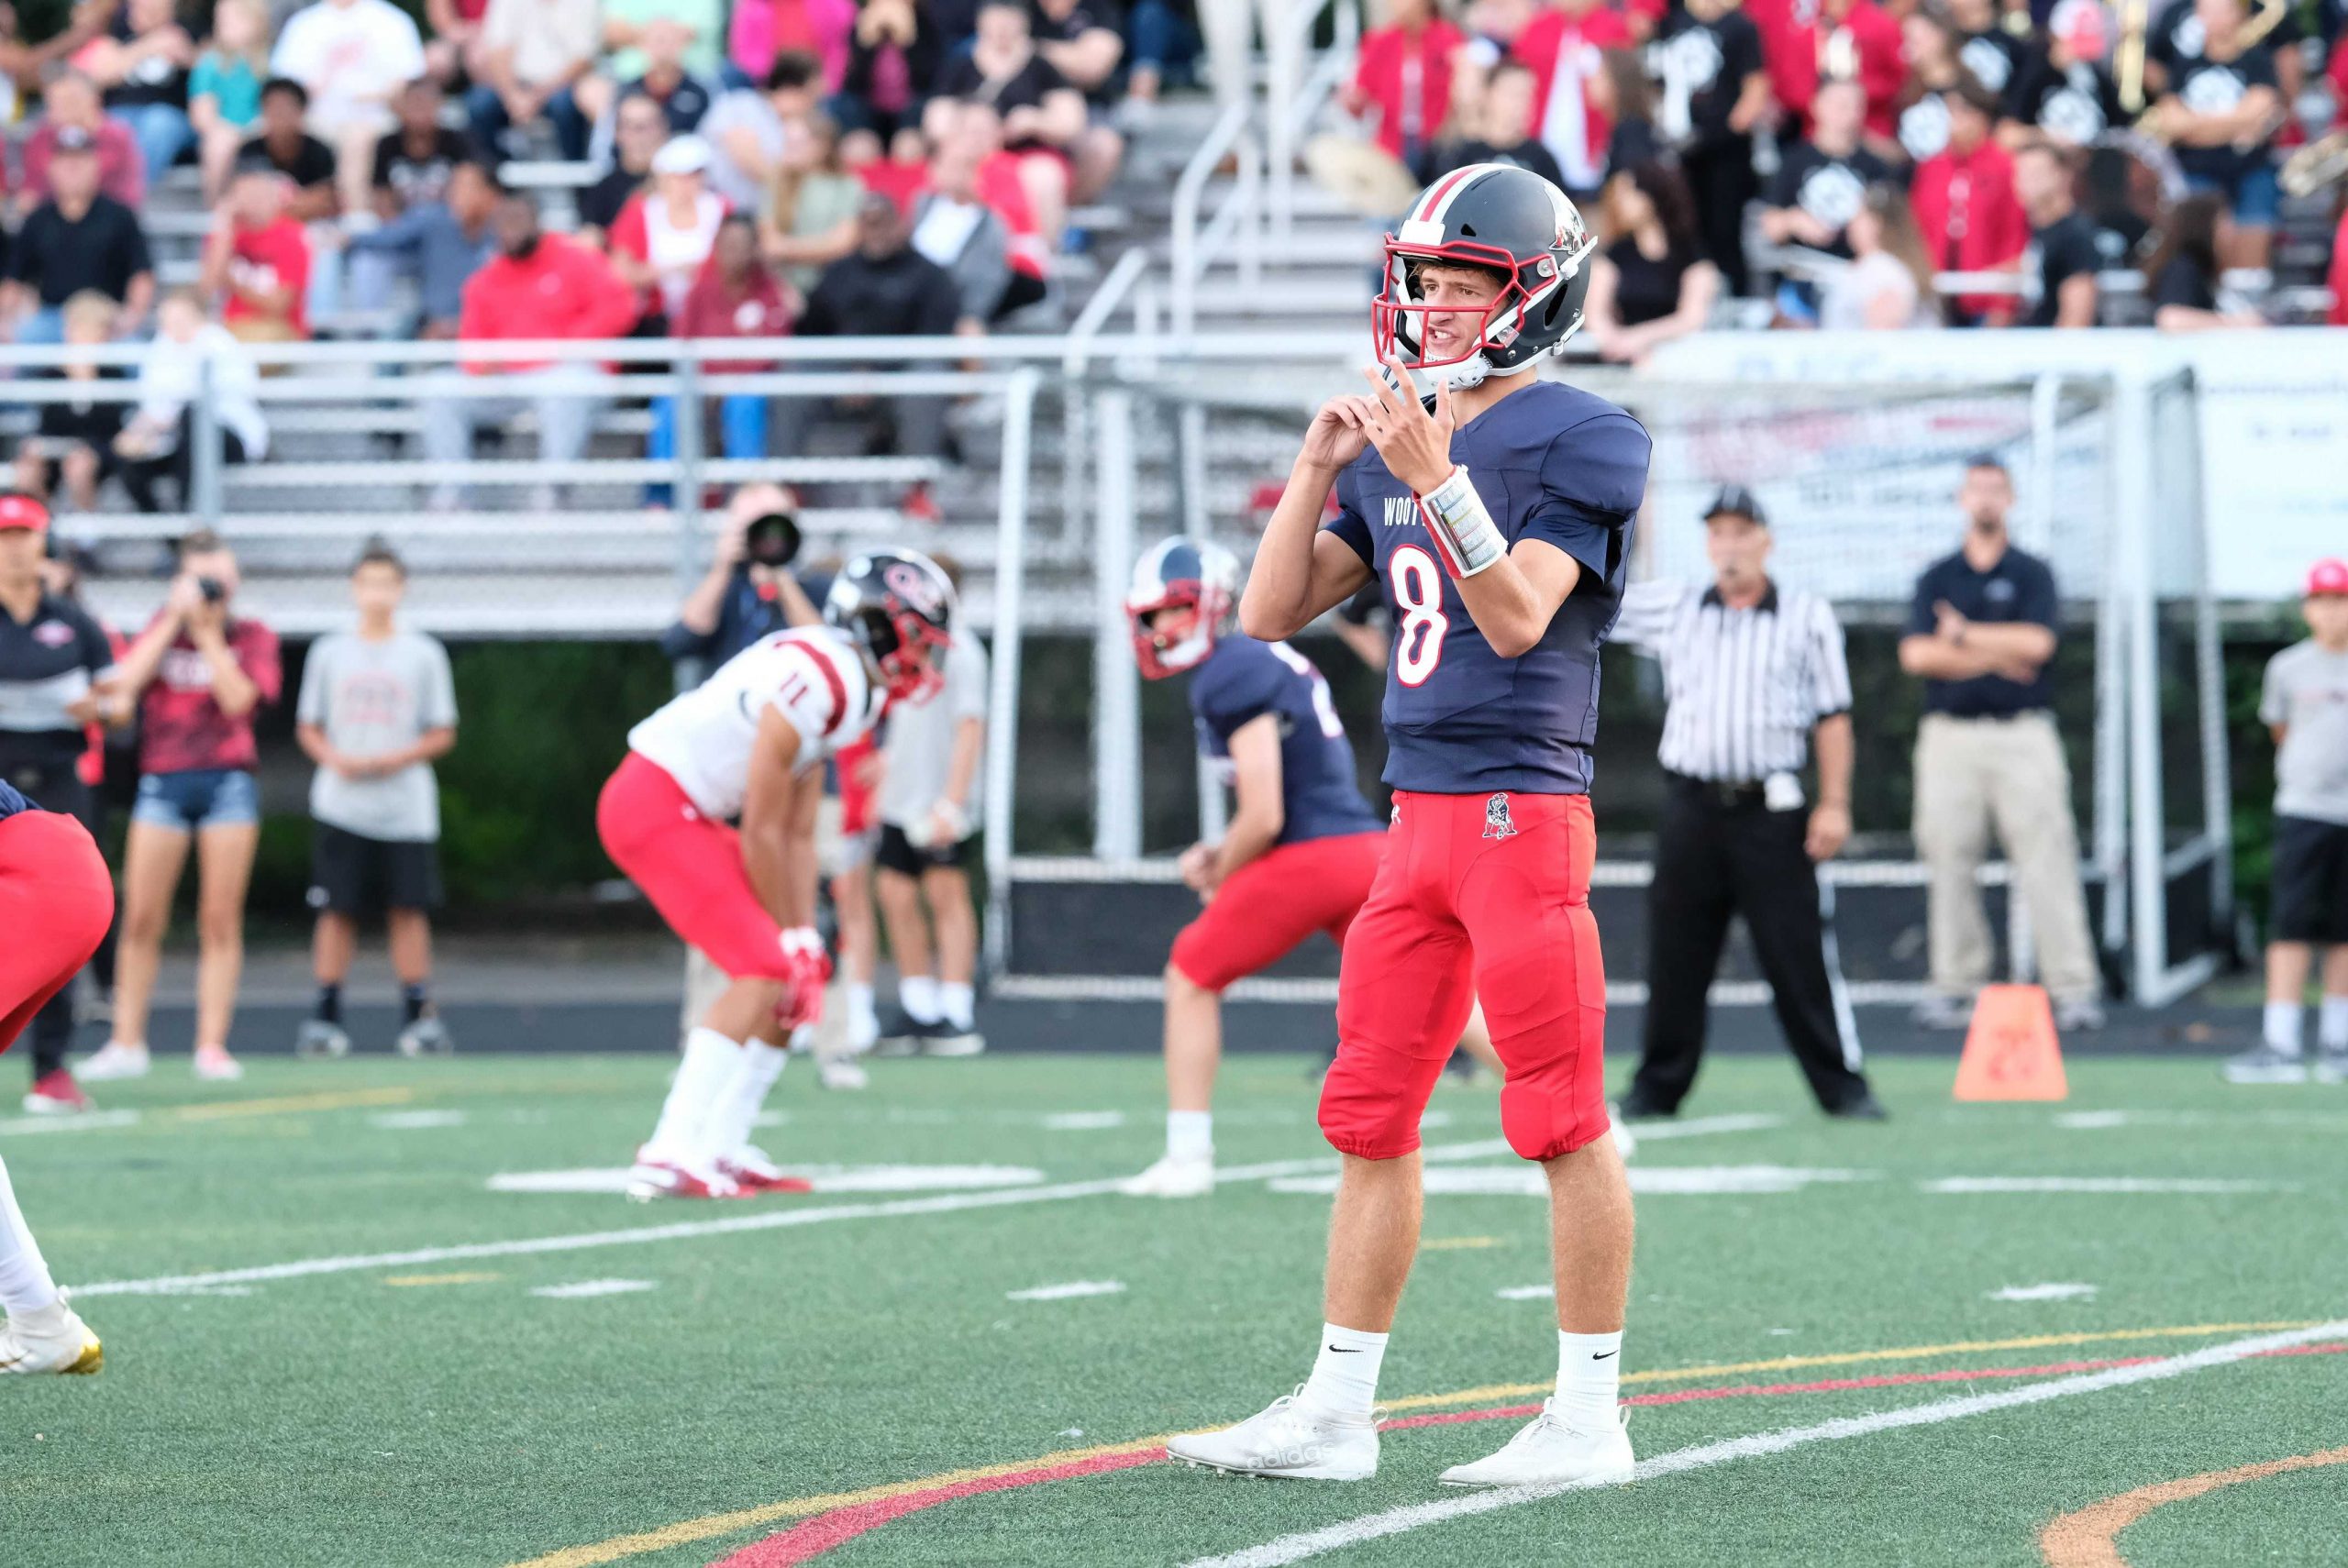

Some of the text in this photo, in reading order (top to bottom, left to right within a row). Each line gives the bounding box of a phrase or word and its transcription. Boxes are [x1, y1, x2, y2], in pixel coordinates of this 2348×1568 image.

[1384, 496, 1425, 526] WOOT
[1389, 544, 1449, 687] 8
[780, 671, 809, 707] 11
[1247, 1441, 1336, 1469] adidas
